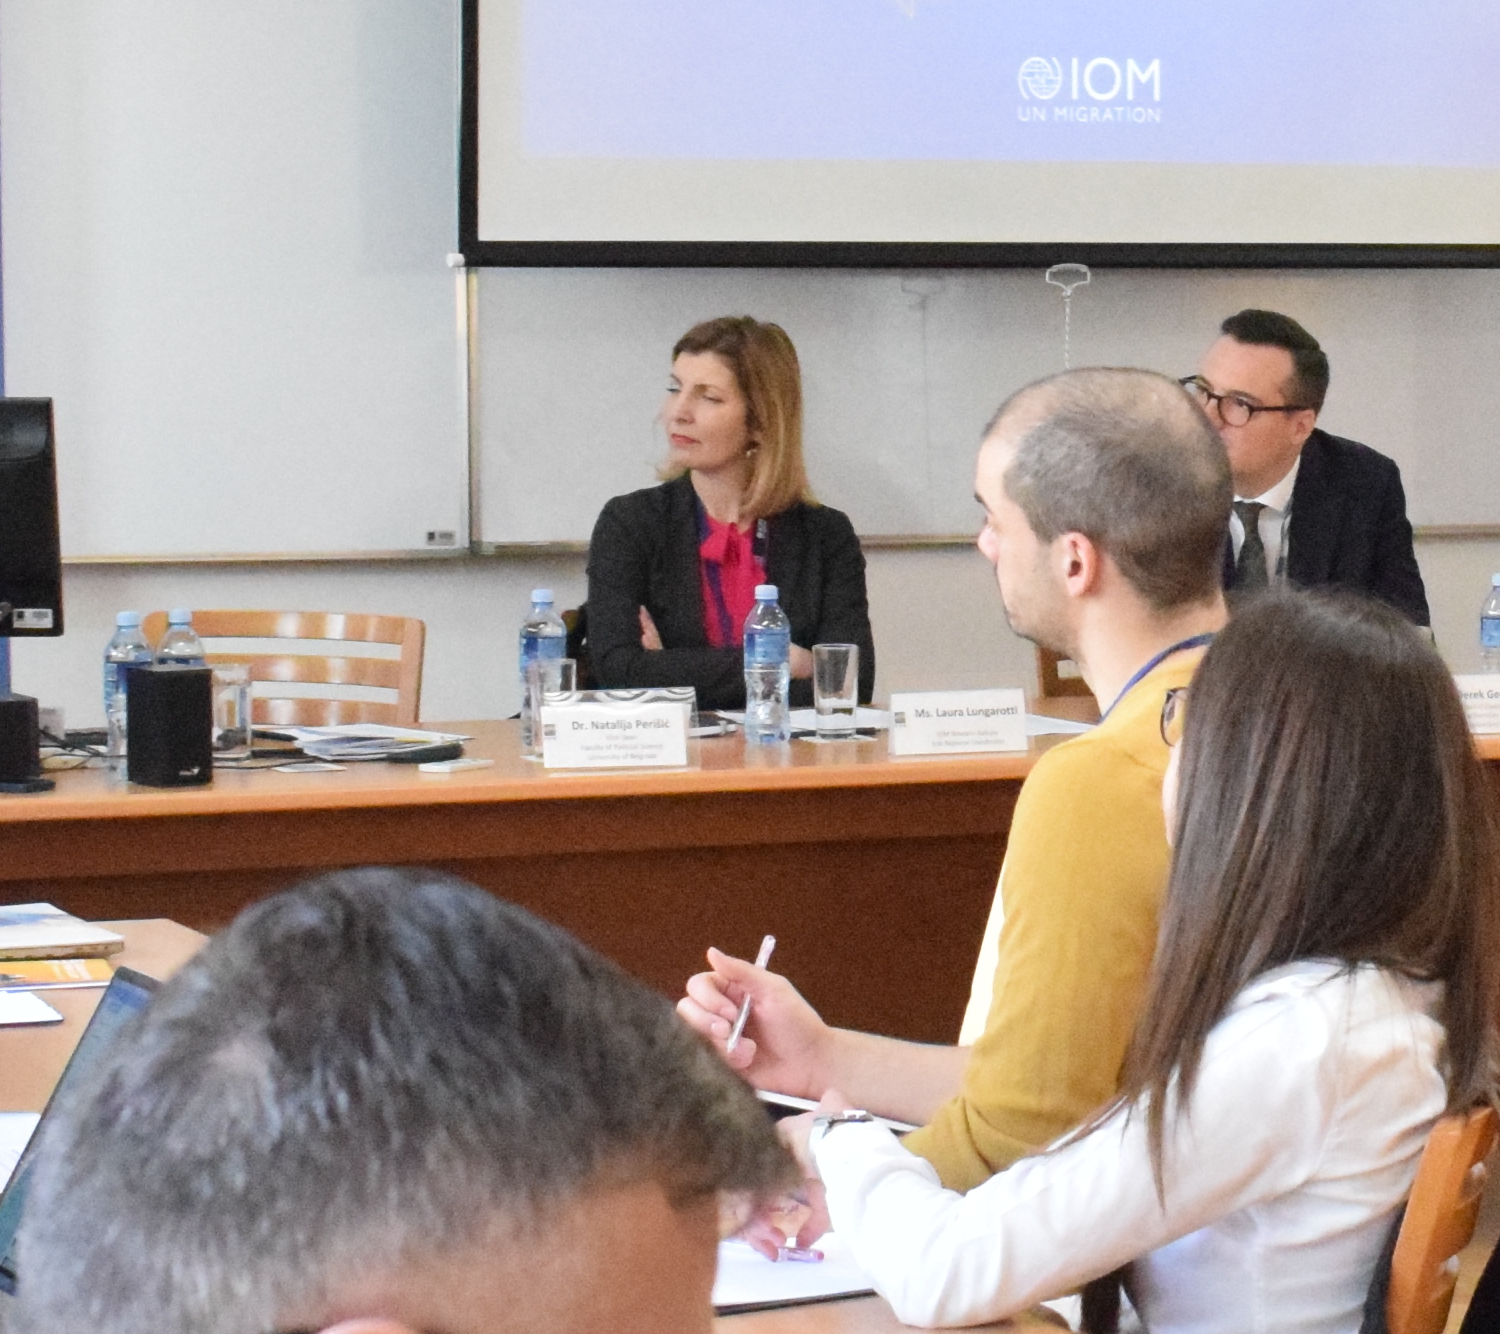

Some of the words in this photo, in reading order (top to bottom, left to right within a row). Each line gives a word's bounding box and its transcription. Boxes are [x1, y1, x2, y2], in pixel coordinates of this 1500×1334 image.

[1071, 56, 1162, 102] IOM
[1018, 106, 1046, 123] UN
[1053, 106, 1162, 124] MIGRATION
[915, 709, 933, 719] Ms.
[936, 708, 964, 718] Laura
[966, 705, 1018, 718] Lungarotti
[572, 721, 588, 731] Dr.
